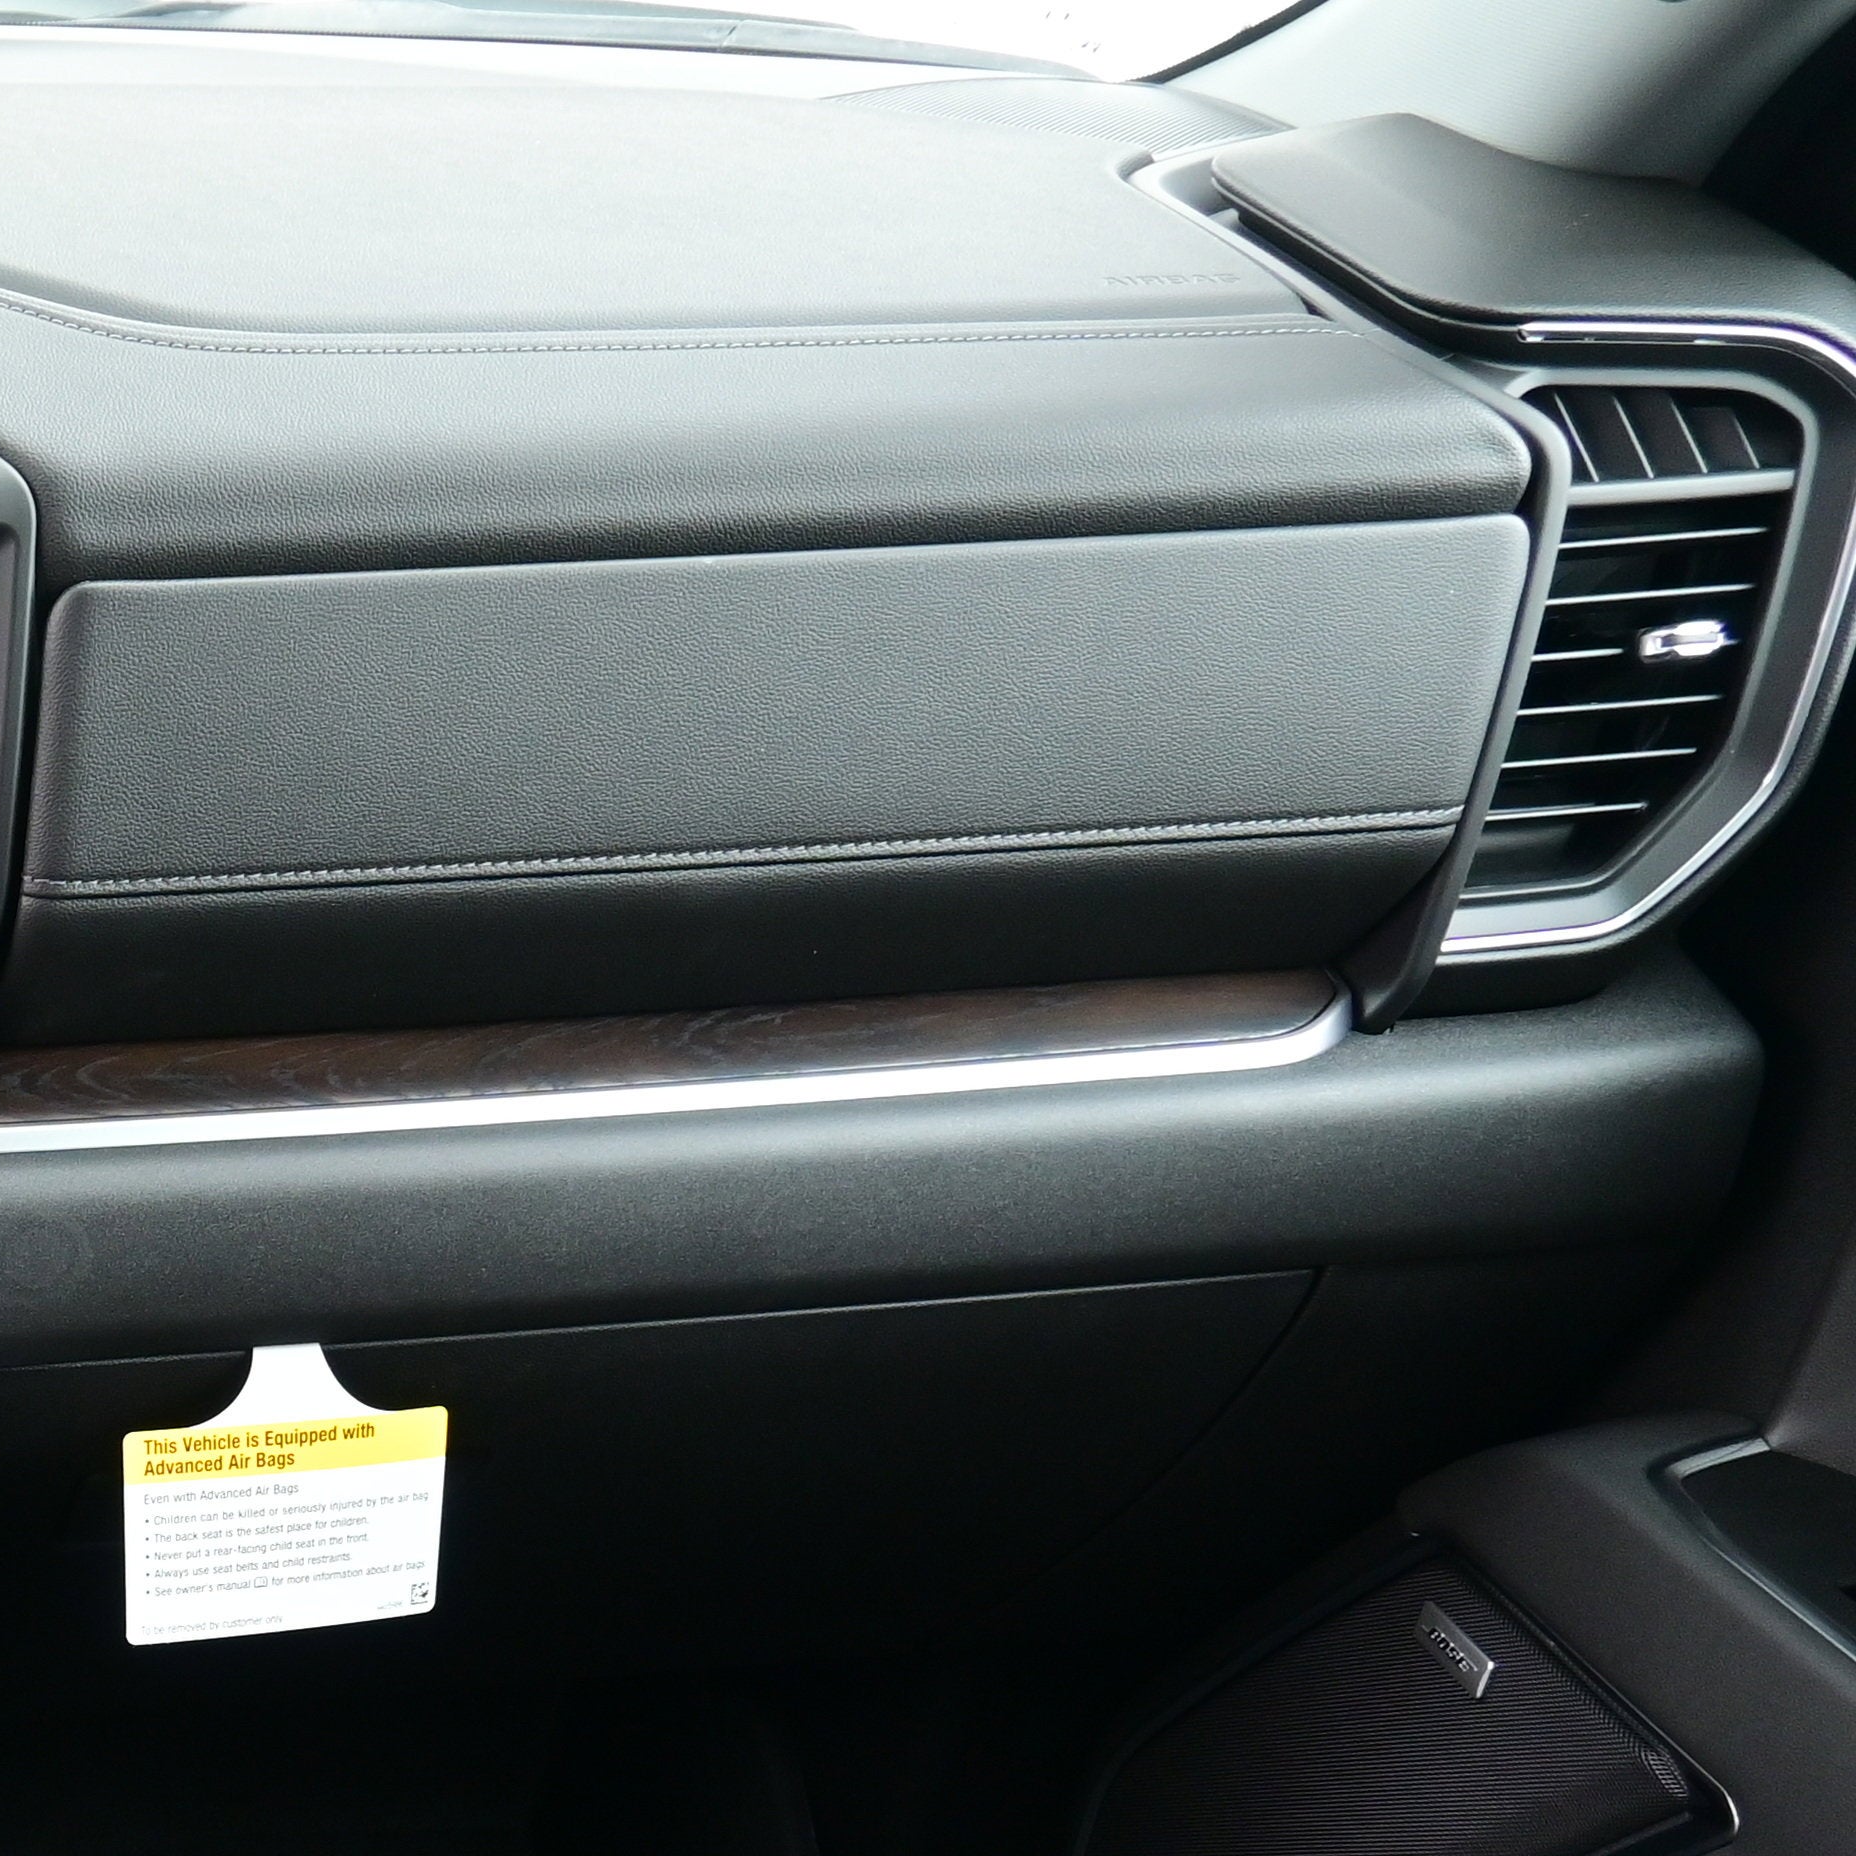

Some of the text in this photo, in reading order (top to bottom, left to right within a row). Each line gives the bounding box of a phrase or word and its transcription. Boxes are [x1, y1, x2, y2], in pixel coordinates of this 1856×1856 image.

[1103, 273, 1240, 286] AIRBAG
[144, 1422, 375, 1455] This Vehicle is Equipped with
[144, 1451, 295, 1476] Advanced Air Bags
[144, 1484, 299, 1505] Even with Advanced Air Bags
[154, 1514, 197, 1525] Children
[200, 1512, 218, 1522] can
[222, 1511, 234, 1520] be
[238, 1508, 265, 1518] killed
[269, 1508, 278, 1516] or
[282, 1503, 326, 1515] seriously
[330, 1499, 363, 1511] injured
[366, 1498, 376, 1508] by
[380, 1496, 394, 1505] the
[397, 1493, 409, 1503] air
[155, 1533, 172, 1543] The
[175, 1531, 198, 1542] back
[202, 1529, 222, 1539] seat
[225, 1529, 233, 1538] is
[237, 1527, 252, 1536] the
[255, 1524, 284, 1535] safest
[287, 1522, 312, 1533] place
[315, 1520, 327, 1529] for
[155, 1551, 182, 1561] Never
[186, 1549, 201, 1560] put
[205, 1549, 210, 1557] a
[214, 1544, 267, 1556] rear-facing
[270, 1541, 292, 1551] child
[295, 1538, 315, 1549] seat
[318, 1538, 326, 1546] in
[329, 1536, 343, 1545] the
[155, 1568, 189, 1579] Always
[192, 1567, 209, 1576] use
[213, 1564, 233, 1574] seat
[236, 1562, 259, 1572] belts
[262, 1560, 279, 1569] and
[282, 1557, 304, 1568] child
[155, 1587, 172, 1597] See
[216, 1580, 250, 1590] manual
[272, 1576, 284, 1585] for
[287, 1574, 310, 1584] more
[313, 1568, 363, 1581] information
[366, 1565, 390, 1575] about
[392, 1563, 403, 1572] air
